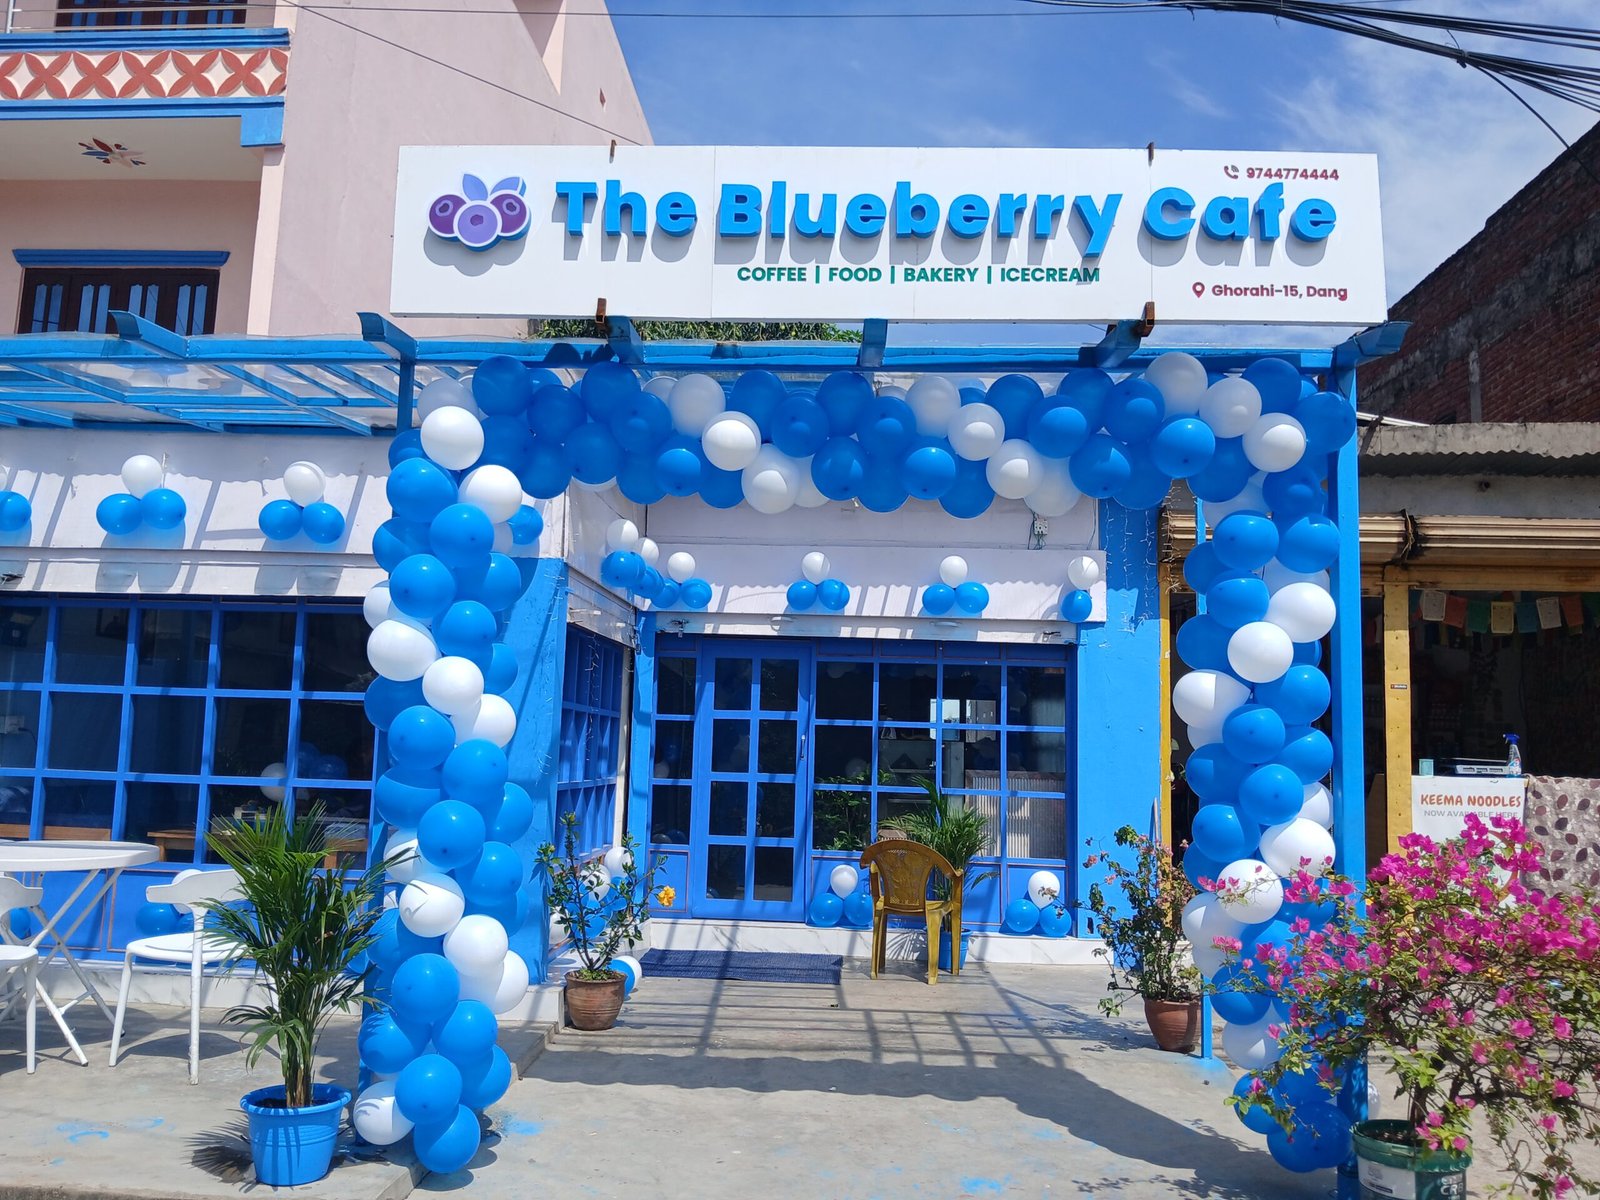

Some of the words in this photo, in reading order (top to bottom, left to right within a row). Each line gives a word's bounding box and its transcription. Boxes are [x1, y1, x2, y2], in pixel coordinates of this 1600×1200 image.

[1246, 167, 1339, 180] 9744774444
[556, 179, 698, 237] The
[720, 180, 1122, 258] Blueberry
[1142, 182, 1337, 242] Cafe
[737, 267, 807, 281] COFFEE
[829, 267, 882, 282] FOOD
[904, 267, 979, 282] BAKERY
[1001, 267, 1100, 282] ICECREAM
[1211, 284, 1303, 298] Ghorahi-15,
[1306, 285, 1348, 301] Dang
[1421, 794, 1463, 806] KEEMA
[1467, 795, 1521, 807] NOODLES
